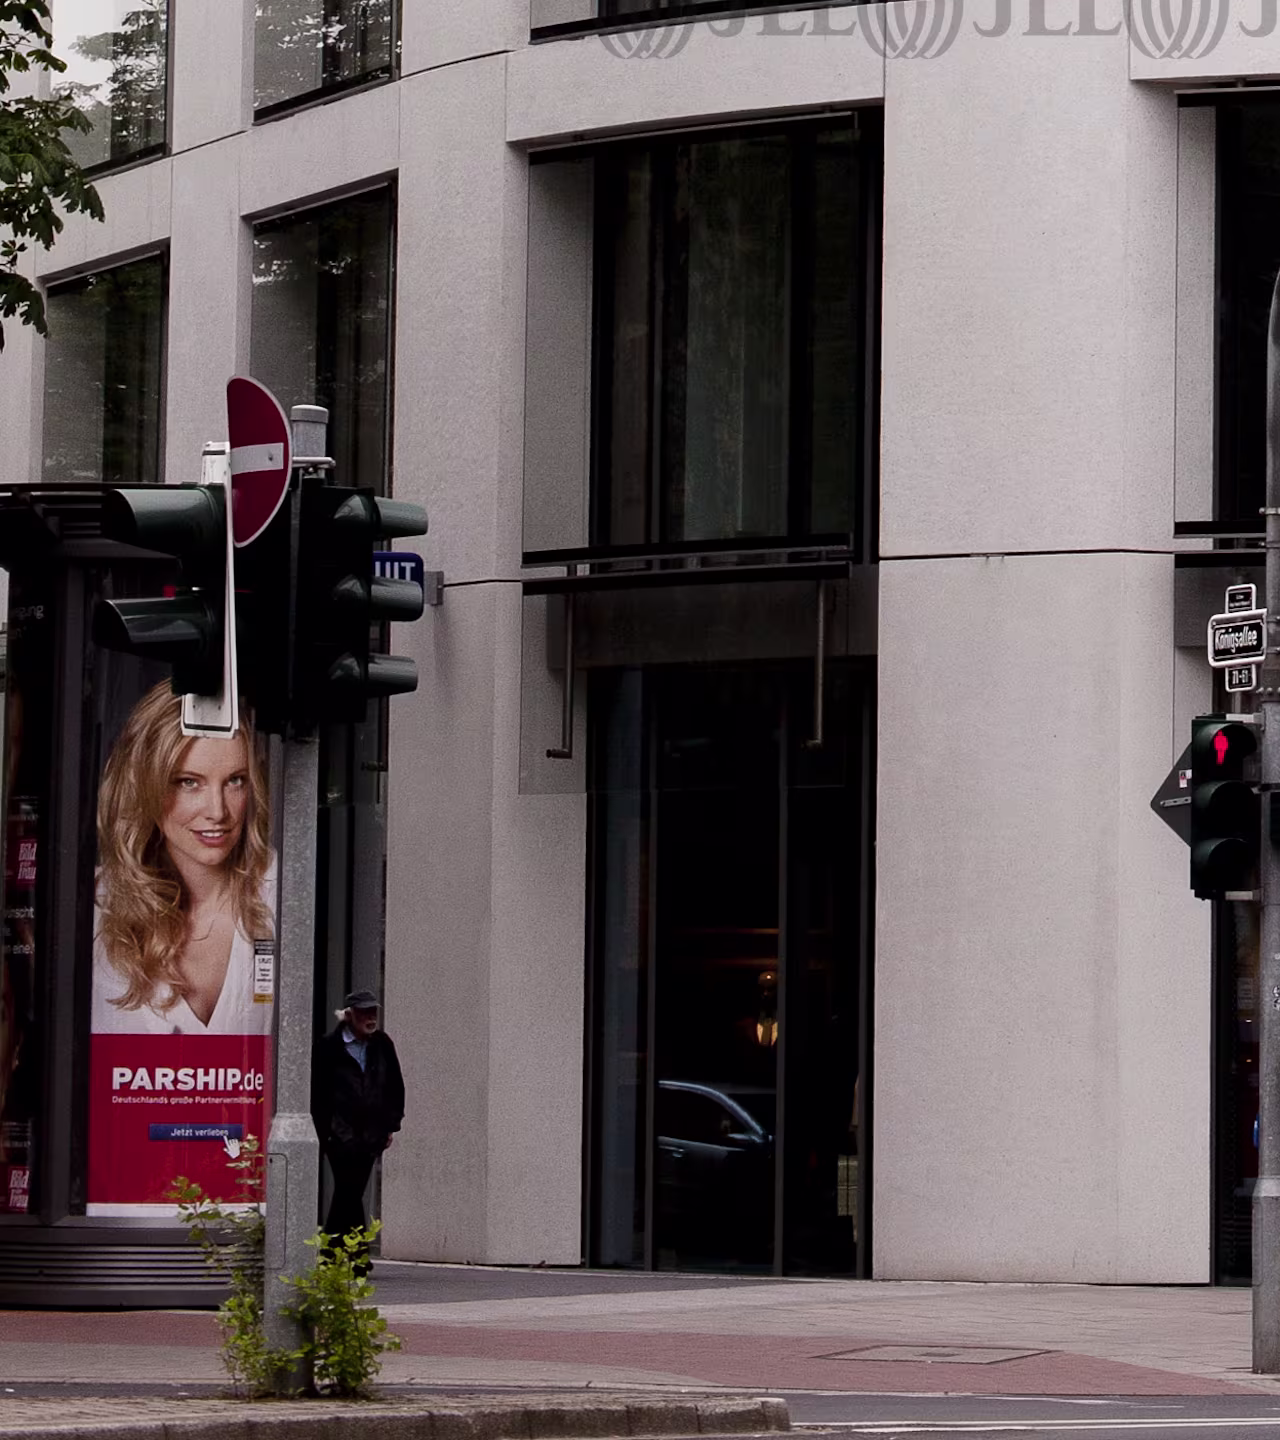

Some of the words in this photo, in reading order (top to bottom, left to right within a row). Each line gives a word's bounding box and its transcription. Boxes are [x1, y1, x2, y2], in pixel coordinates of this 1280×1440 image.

[374, 561, 416, 581] UIT
[1214, 625, 1258, 654] Königsallee
[112, 1067, 264, 1091] PARSHIP.de
[112, 1095, 168, 1105] Deutschlands
[170, 1127, 193, 1137] Jetzt
